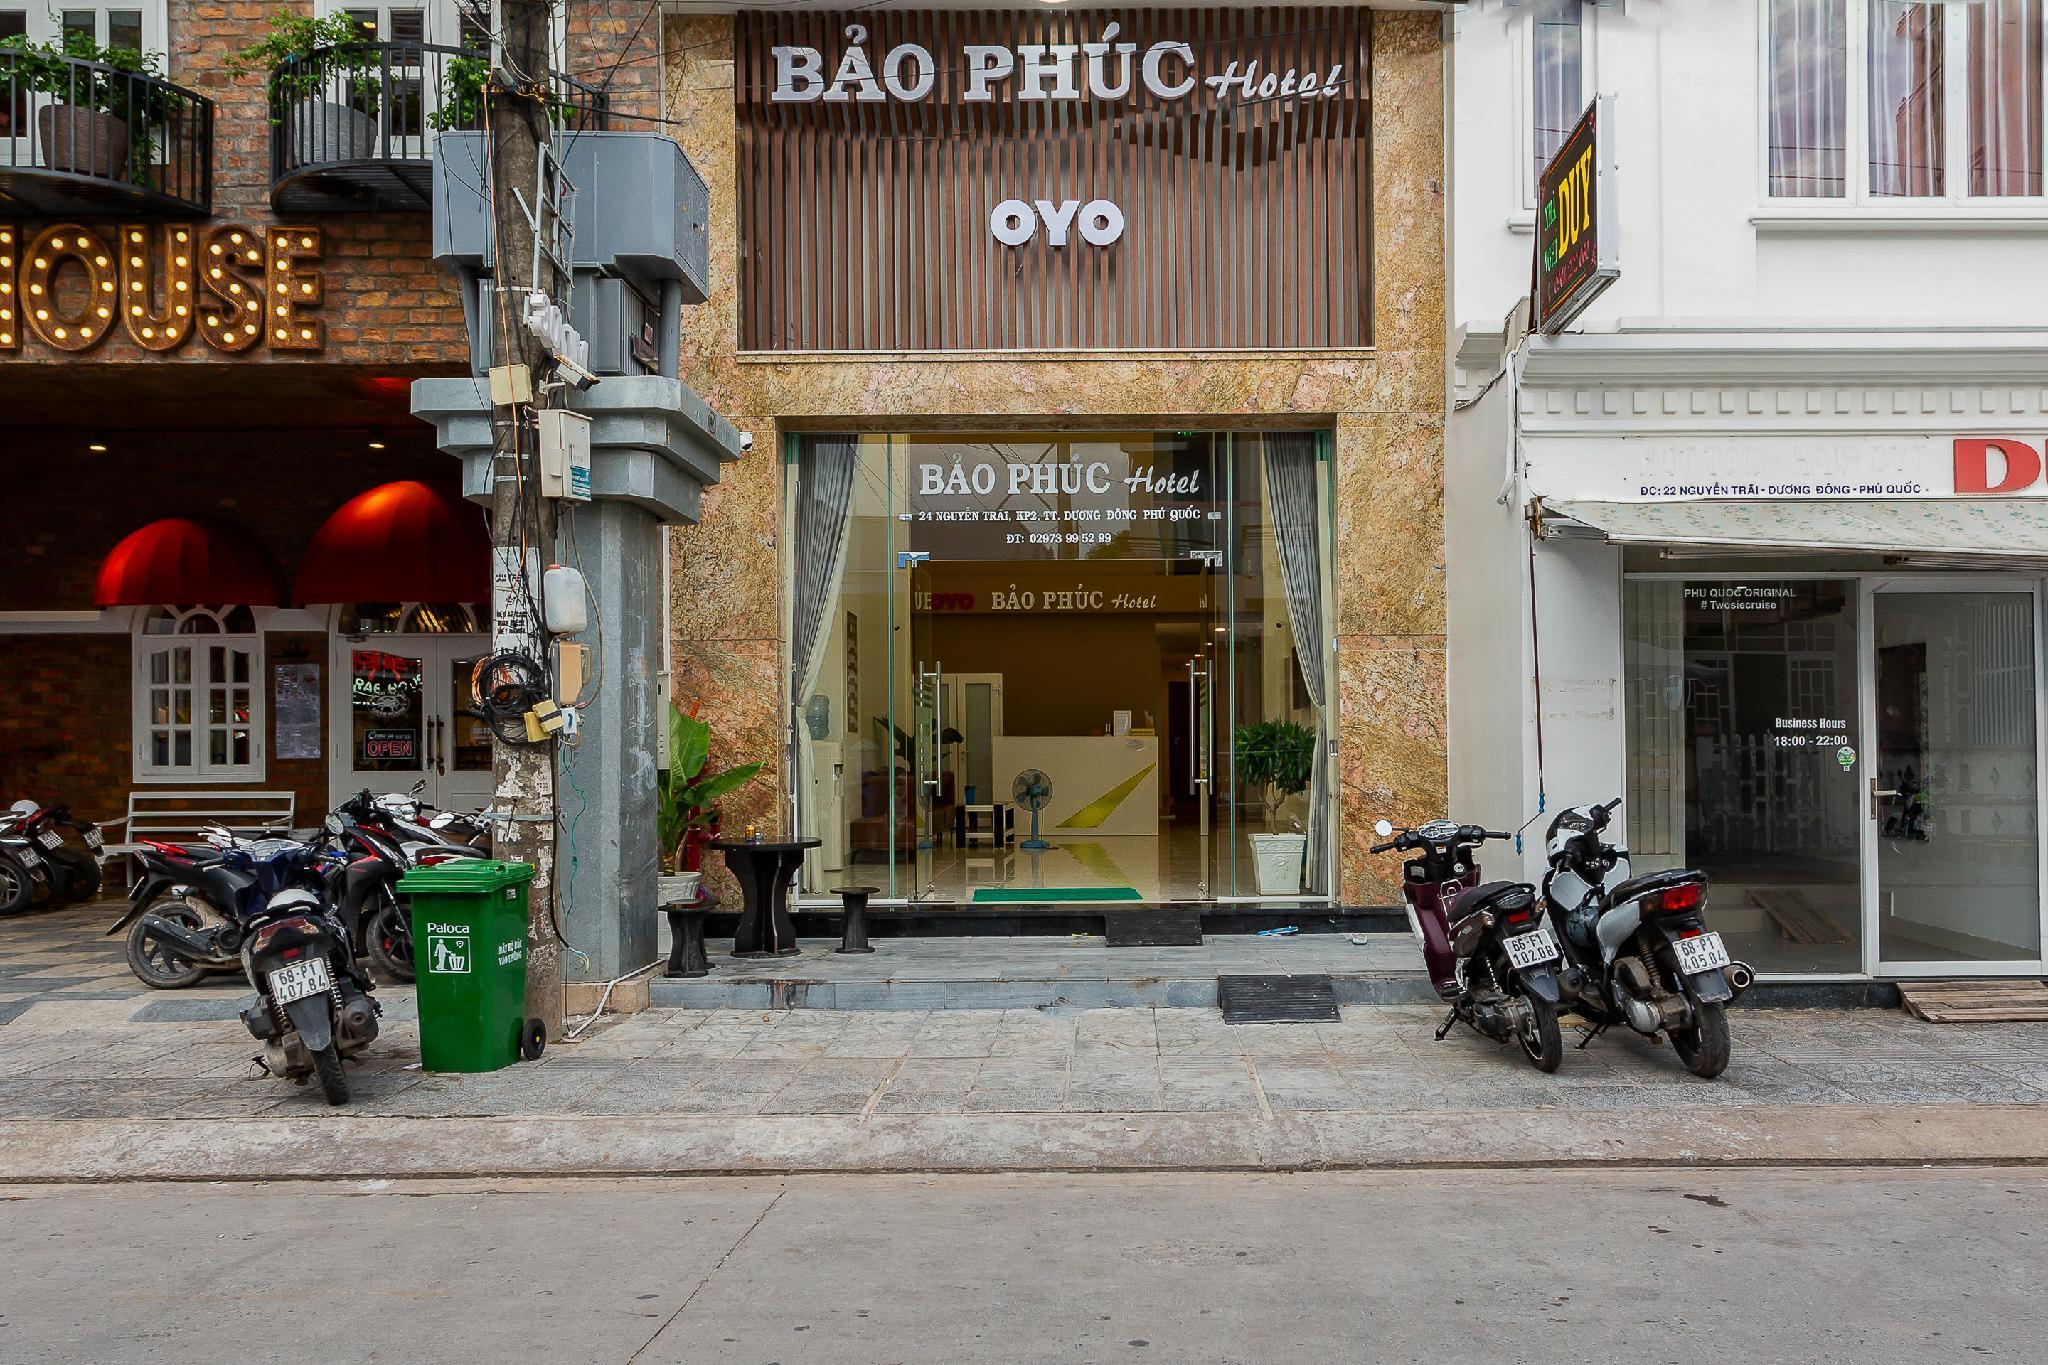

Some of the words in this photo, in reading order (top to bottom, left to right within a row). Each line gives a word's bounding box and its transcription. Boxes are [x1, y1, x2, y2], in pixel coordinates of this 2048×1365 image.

[771, 25, 935, 102] BẢO
[963, 22, 1195, 101] PHÚC
[1205, 62, 1341, 99] Hotel
[1558, 143, 1592, 259] DUY
[990, 199, 1124, 247] OYO
[919, 452, 996, 495] BẢO
[1007, 453, 1111, 495] PHÚC
[1124, 465, 1200, 494] Hotel
[1953, 439, 2048, 493] D
[1663, 486, 1676, 495] 22
[1768, 484, 1811, 494] DƯƠNG
[1816, 483, 1850, 494] ĐÔNG
[1859, 483, 1882, 494] PHÚ
[1886, 481, 1921, 494] QUỐC
[918, 511, 933, 521] 24
[935, 507, 979, 521] NGUYỄN
[1015, 511, 1040, 522] KP2,
[1042, 511, 1061, 521] TT.
[1106, 508, 1137, 520] ĐÔNG
[1142, 507, 1165, 520] PHÚ
[1169, 505, 1201, 522] QUỐC
[1006, 533, 1025, 543] ĐT:
[1029, 533, 1062, 544] 02973
[1065, 533, 1079, 543] 99
[1081, 533, 1095, 543] 52
[991, 583, 1034, 610] BẢO
[1042, 583, 1104, 610] PHÚC
[1111, 593, 1157, 609] Hotel
[1744, 588, 1797, 597] ORIGINAL
[1709, 600, 1777, 610] Twosiecruise
[1775, 717, 1818, 729] Business
[1819, 717, 1847, 729] Hours
[368, 740, 413, 757] OPEN
[1773, 736, 1806, 747] 18:00
[1815, 735, 1848, 746] 22:00
[427, 922, 470, 934] Paloca
[1511, 933, 1544, 952] 66-F1
[1680, 936, 1715, 956] 68-P1
[1512, 945, 1554, 966] 102.08
[1683, 950, 1725, 970] 405.04
[278, 963, 317, 986] 68-P1
[279, 975, 326, 1001] 407.84
